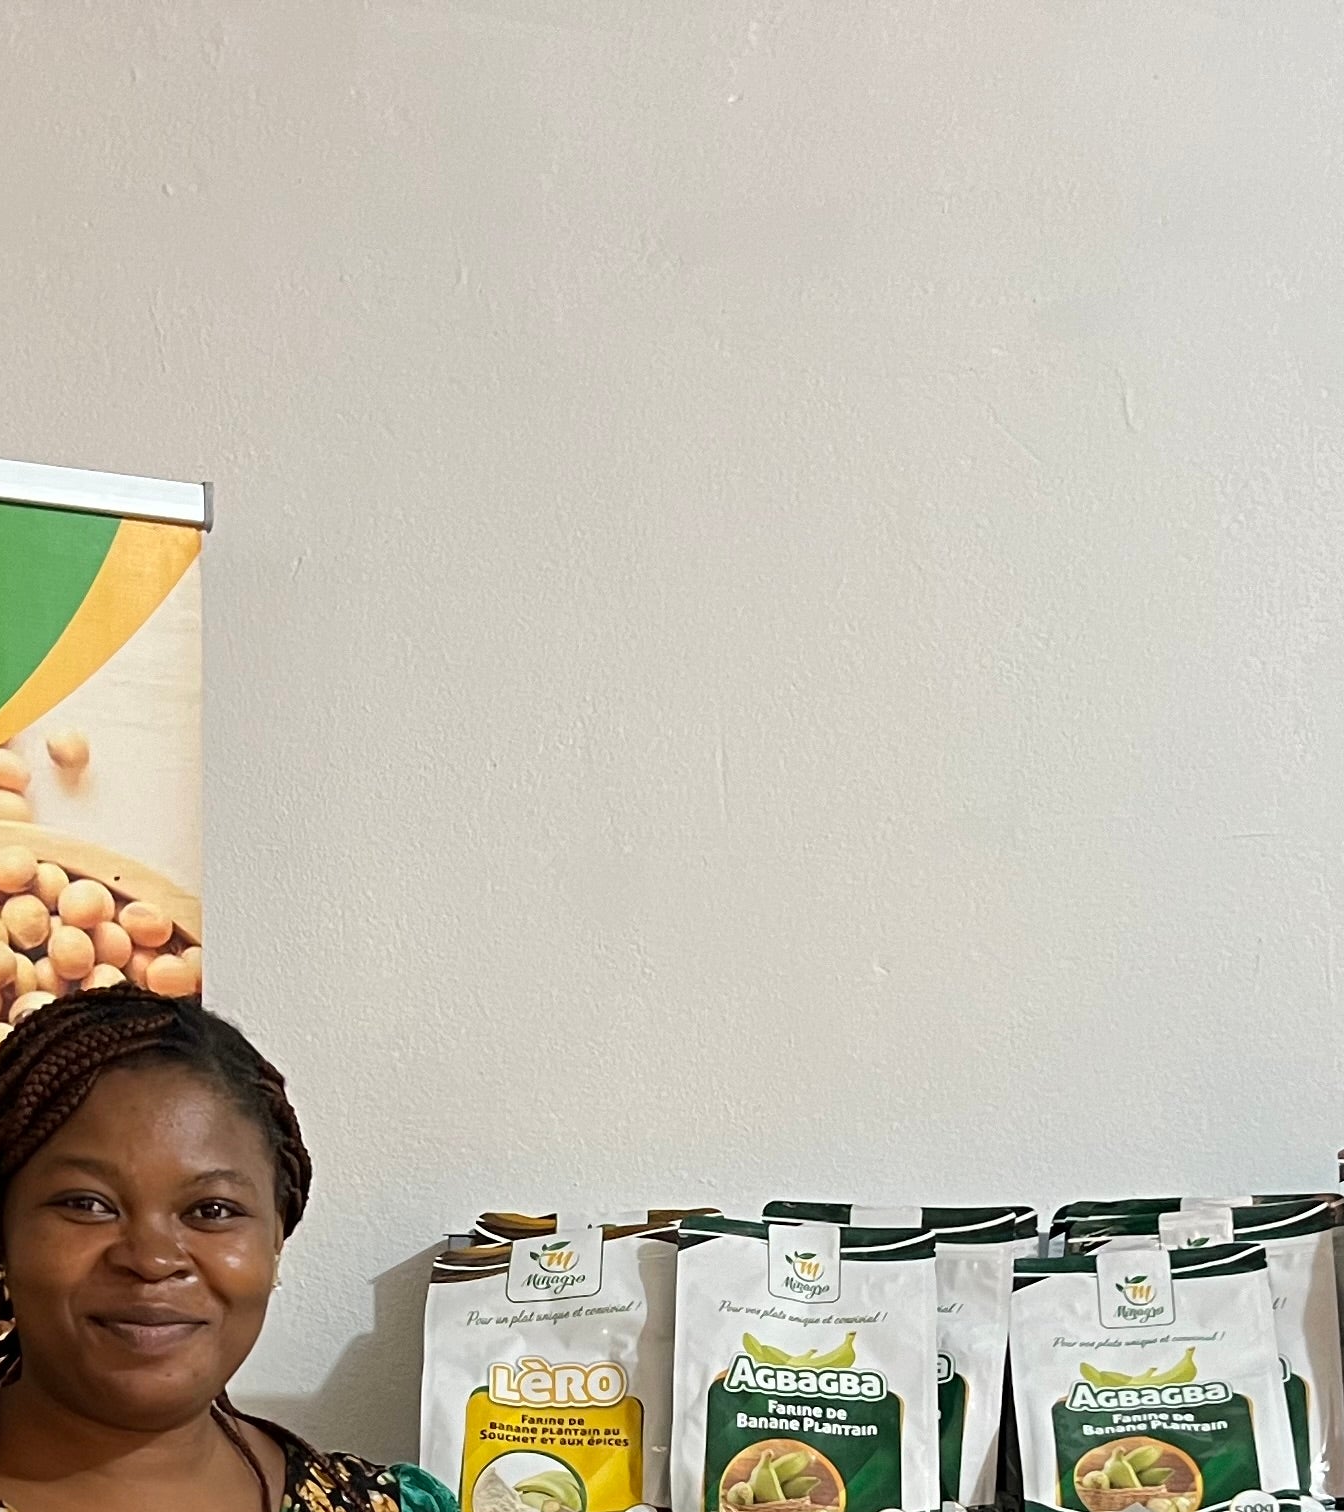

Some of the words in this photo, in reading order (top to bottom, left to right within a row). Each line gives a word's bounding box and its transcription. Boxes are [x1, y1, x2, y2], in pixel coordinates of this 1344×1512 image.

[520, 1273, 587, 1295] Minagro
[781, 1276, 830, 1298] Minagro
[718, 1299, 745, 1313] Pour
[1113, 1304, 1165, 1325] Minagro
[466, 1310, 492, 1327] Pour
